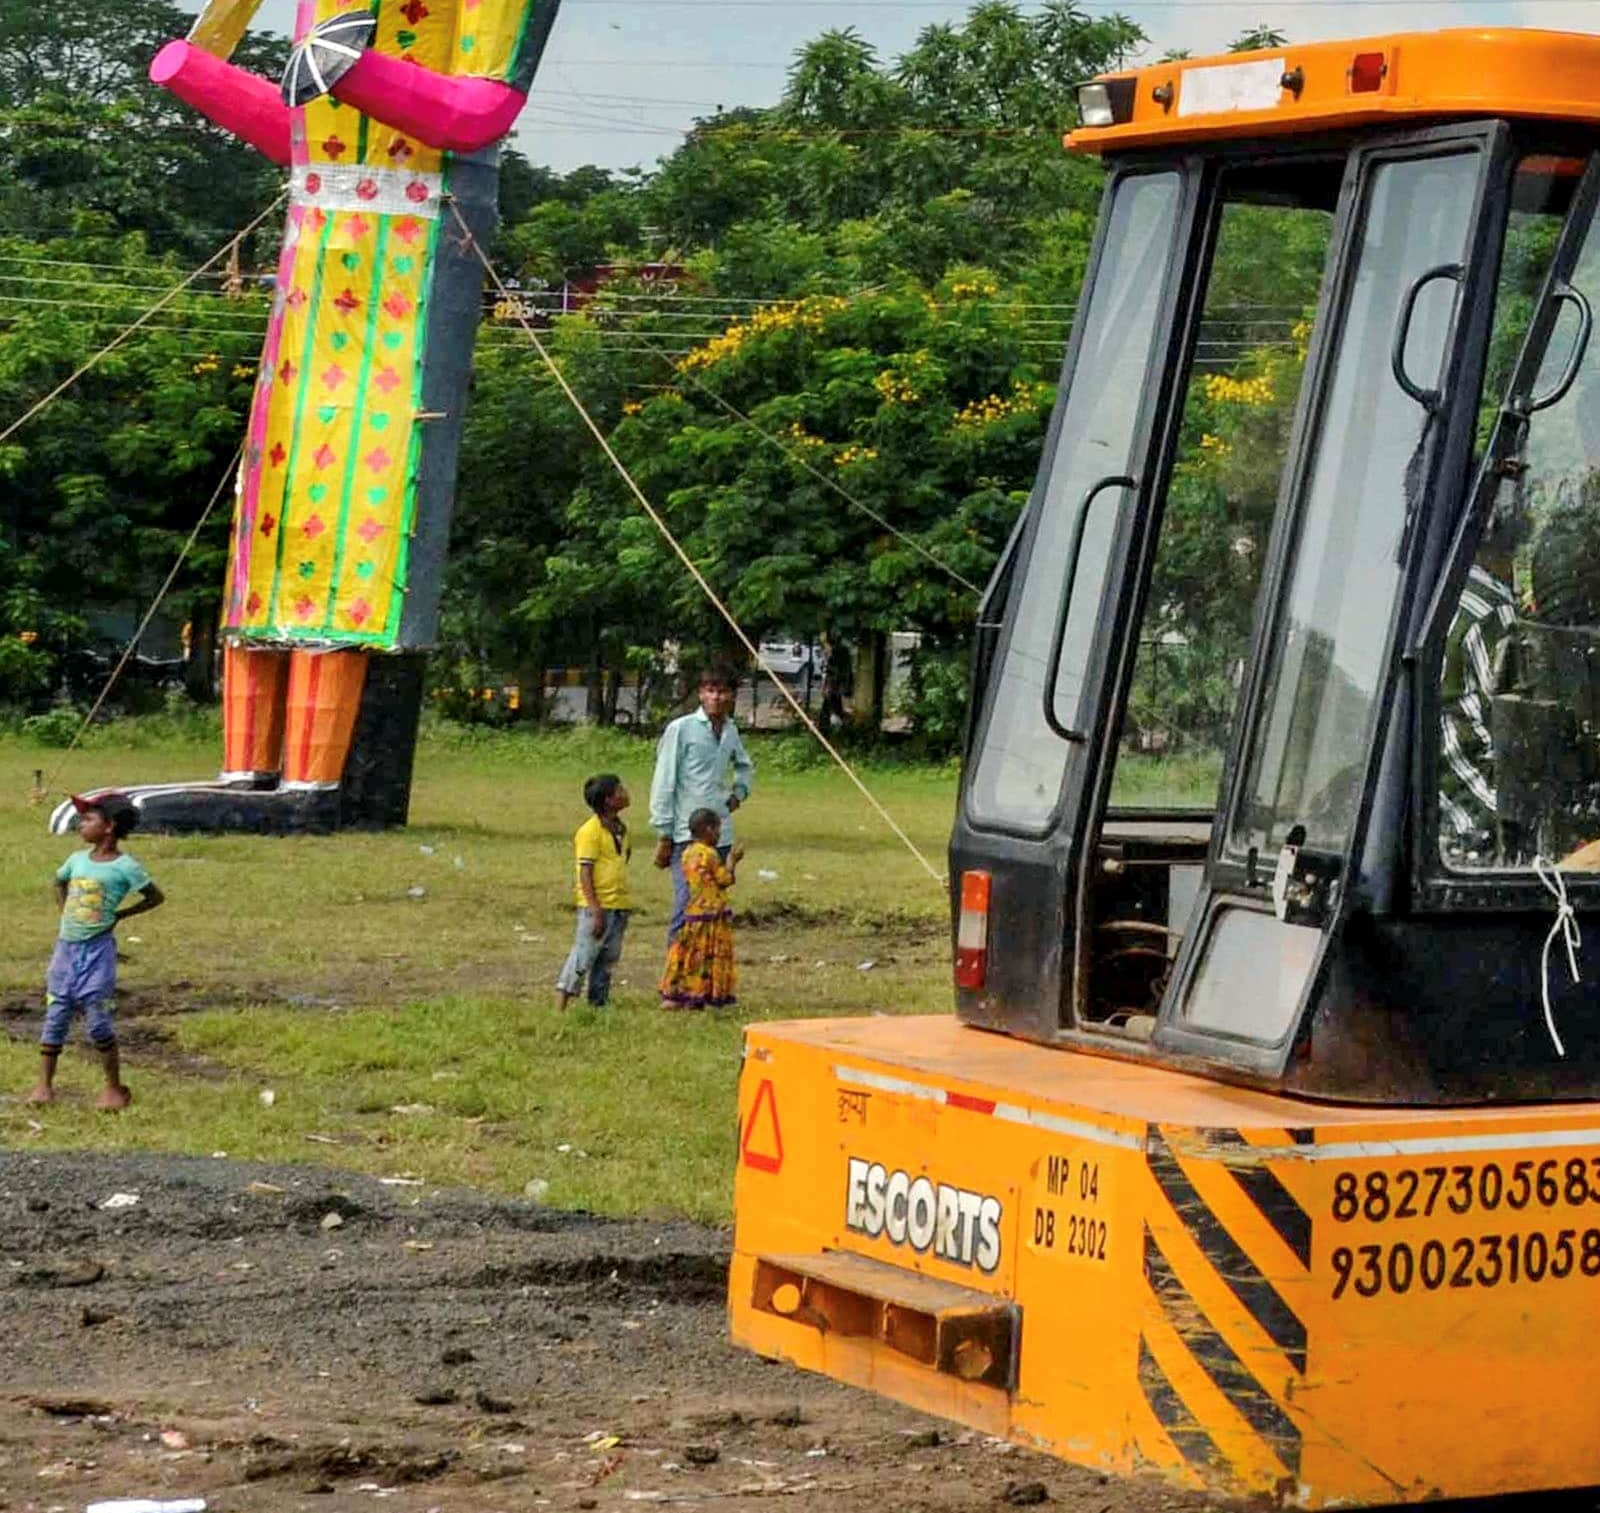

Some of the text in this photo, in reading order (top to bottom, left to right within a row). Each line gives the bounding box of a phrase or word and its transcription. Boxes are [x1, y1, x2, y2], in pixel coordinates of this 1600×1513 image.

[1047, 1155, 1098, 1203] MP 04
[846, 1156, 1003, 1274] ESCORTS
[1034, 1207, 1107, 1261] DB 2302
